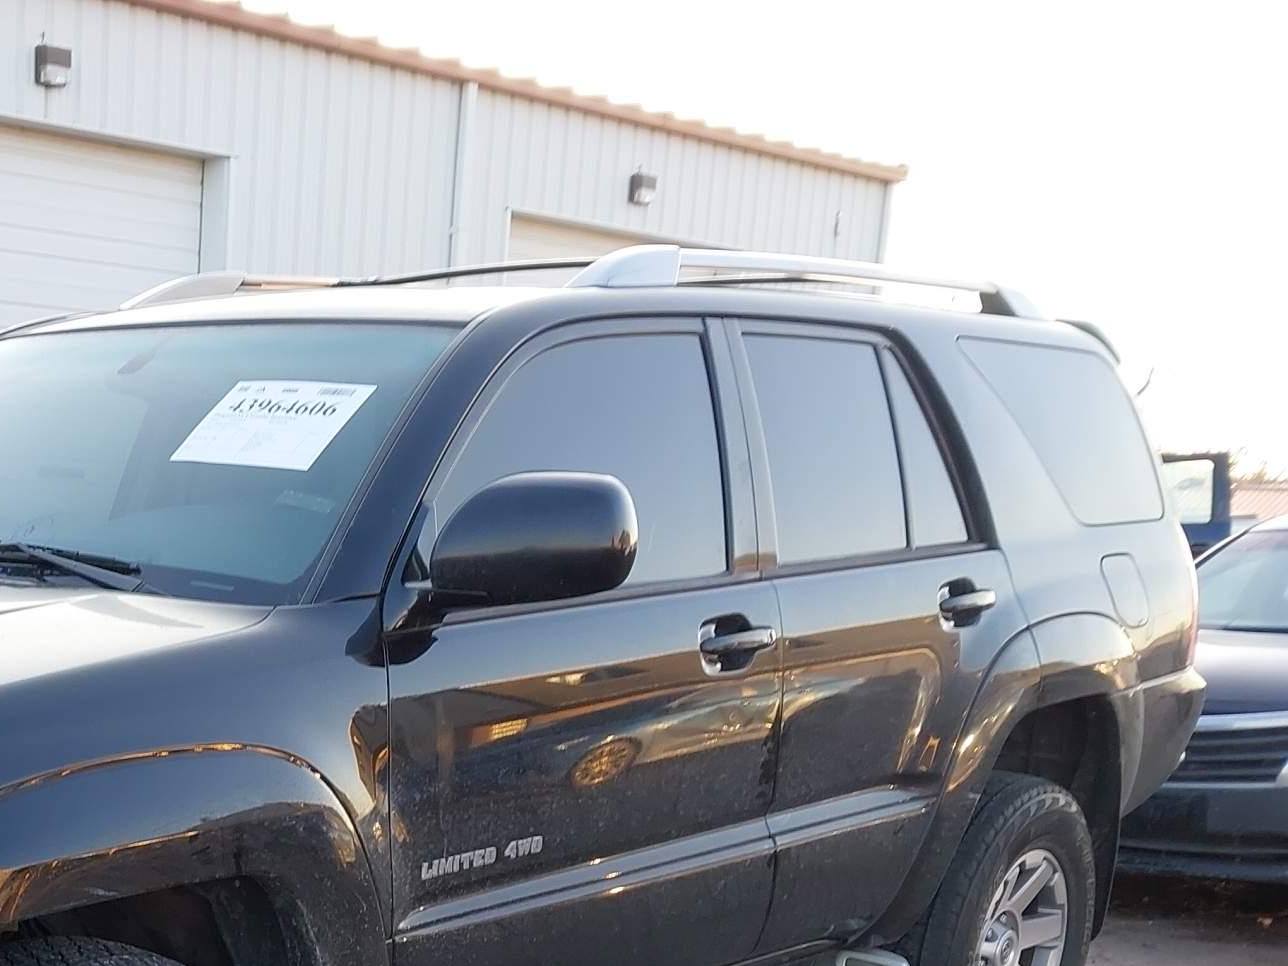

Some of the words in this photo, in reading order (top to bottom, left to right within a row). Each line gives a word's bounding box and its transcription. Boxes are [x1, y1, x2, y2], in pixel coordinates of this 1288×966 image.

[229, 398, 338, 417] 43964606
[421, 846, 497, 881] LIMITED
[504, 835, 544, 859] 4WD
